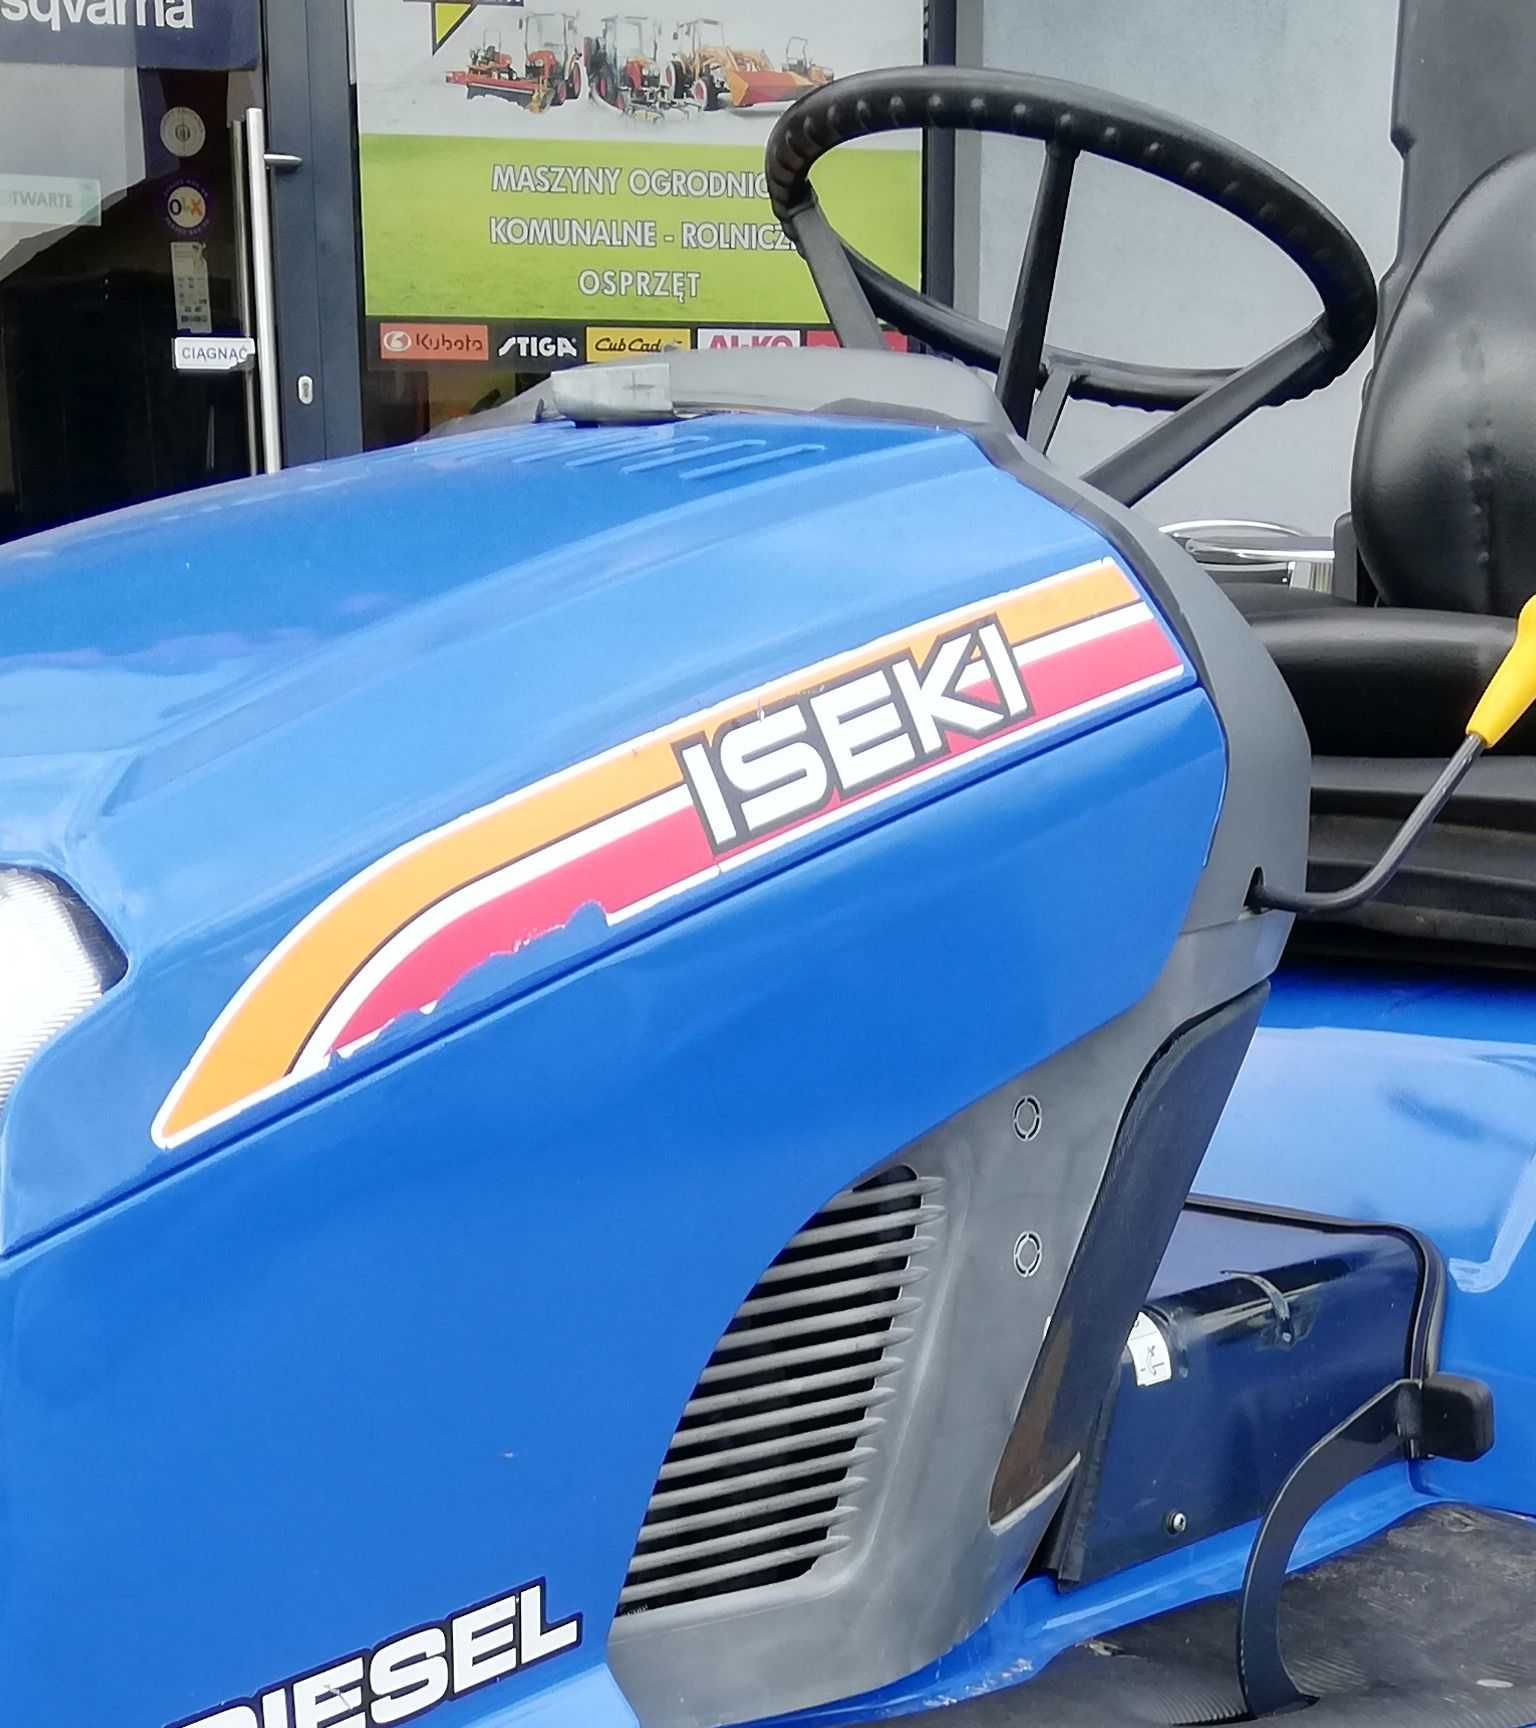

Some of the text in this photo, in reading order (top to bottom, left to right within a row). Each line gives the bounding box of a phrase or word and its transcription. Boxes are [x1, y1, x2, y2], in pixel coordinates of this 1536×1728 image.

[491, 163, 770, 199] MASZYNY OGRODNIC
[7, 190, 73, 209] TWARTE
[489, 217, 657, 248] KOMUNALNE
[578, 269, 701, 304] OSPRZĘT
[415, 333, 484, 351] Kubota
[498, 336, 577, 358] STIGA
[594, 337, 663, 353] Cub Cad
[677, 619, 1031, 848] ISEKI
